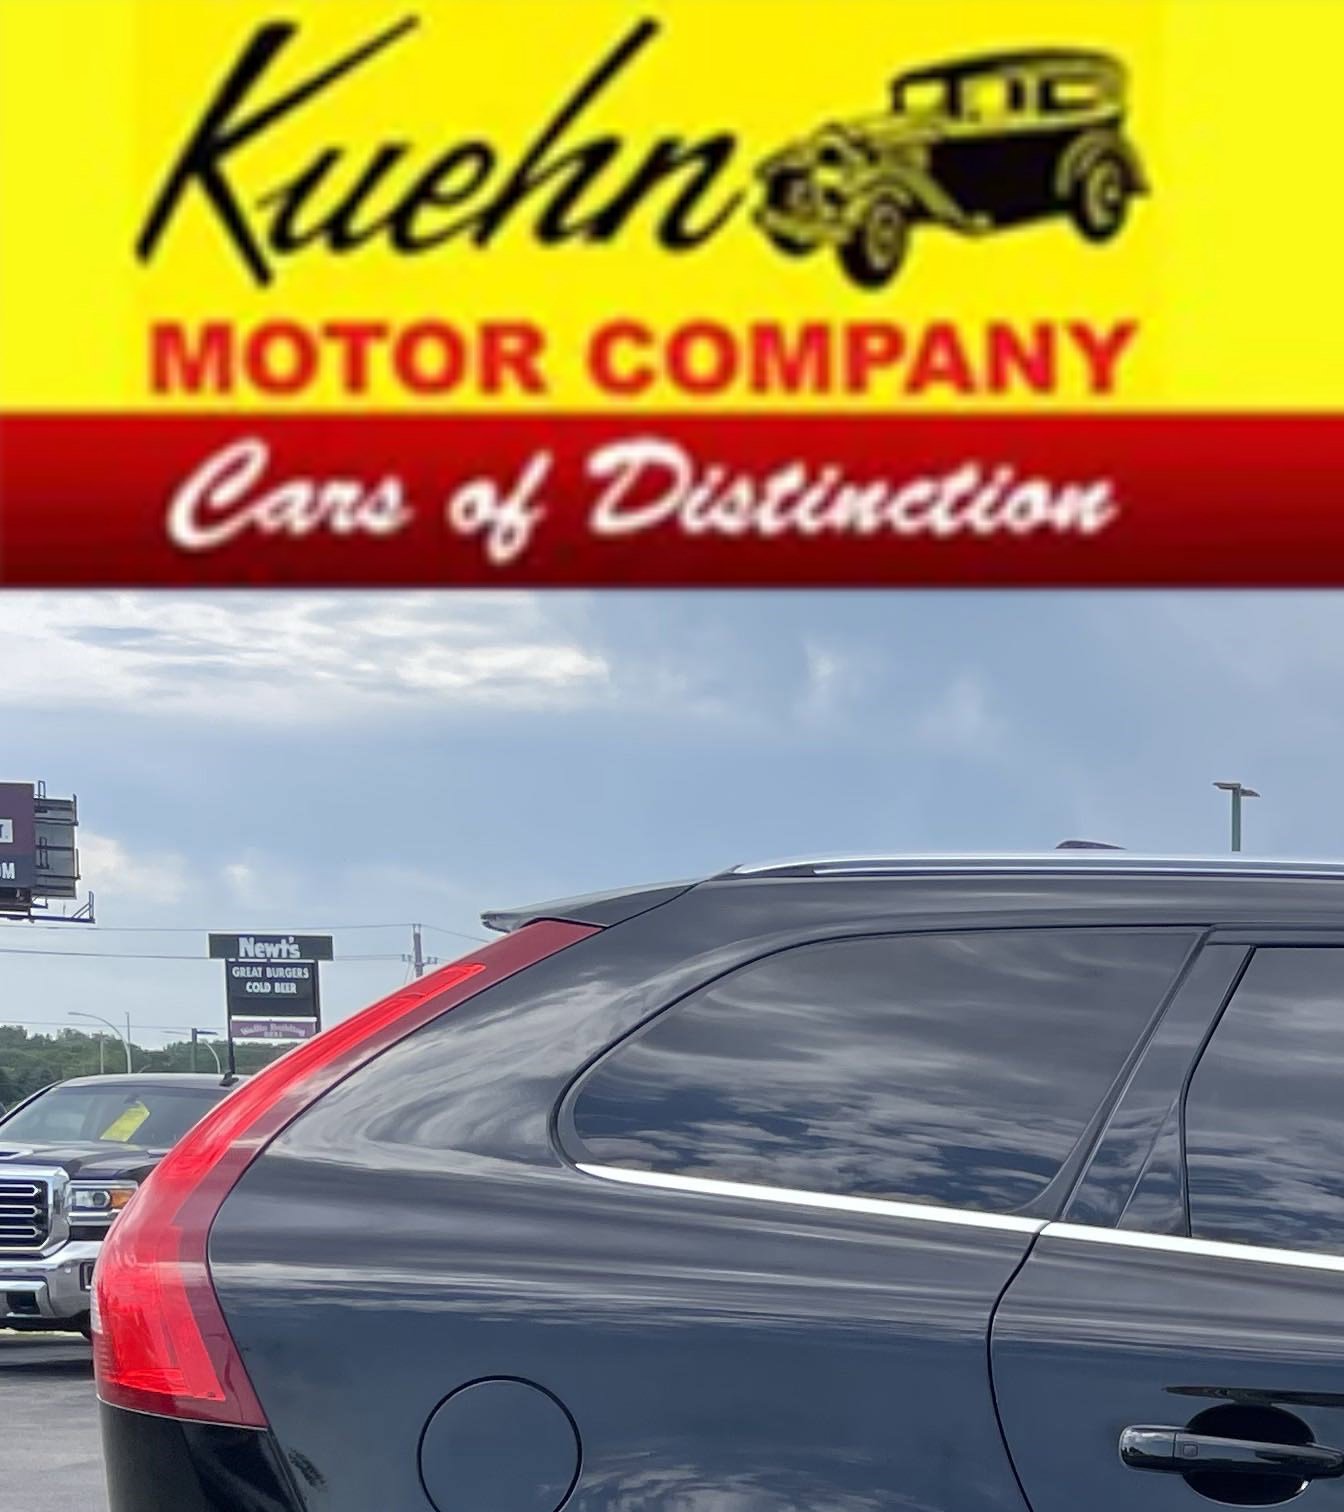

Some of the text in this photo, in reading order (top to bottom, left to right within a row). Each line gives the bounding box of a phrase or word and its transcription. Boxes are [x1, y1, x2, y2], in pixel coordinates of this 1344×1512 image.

[238, 936, 301, 959] Newt's
[232, 966, 309, 979] GREAT BURGERS
[246, 981, 297, 994] COLD BEER
